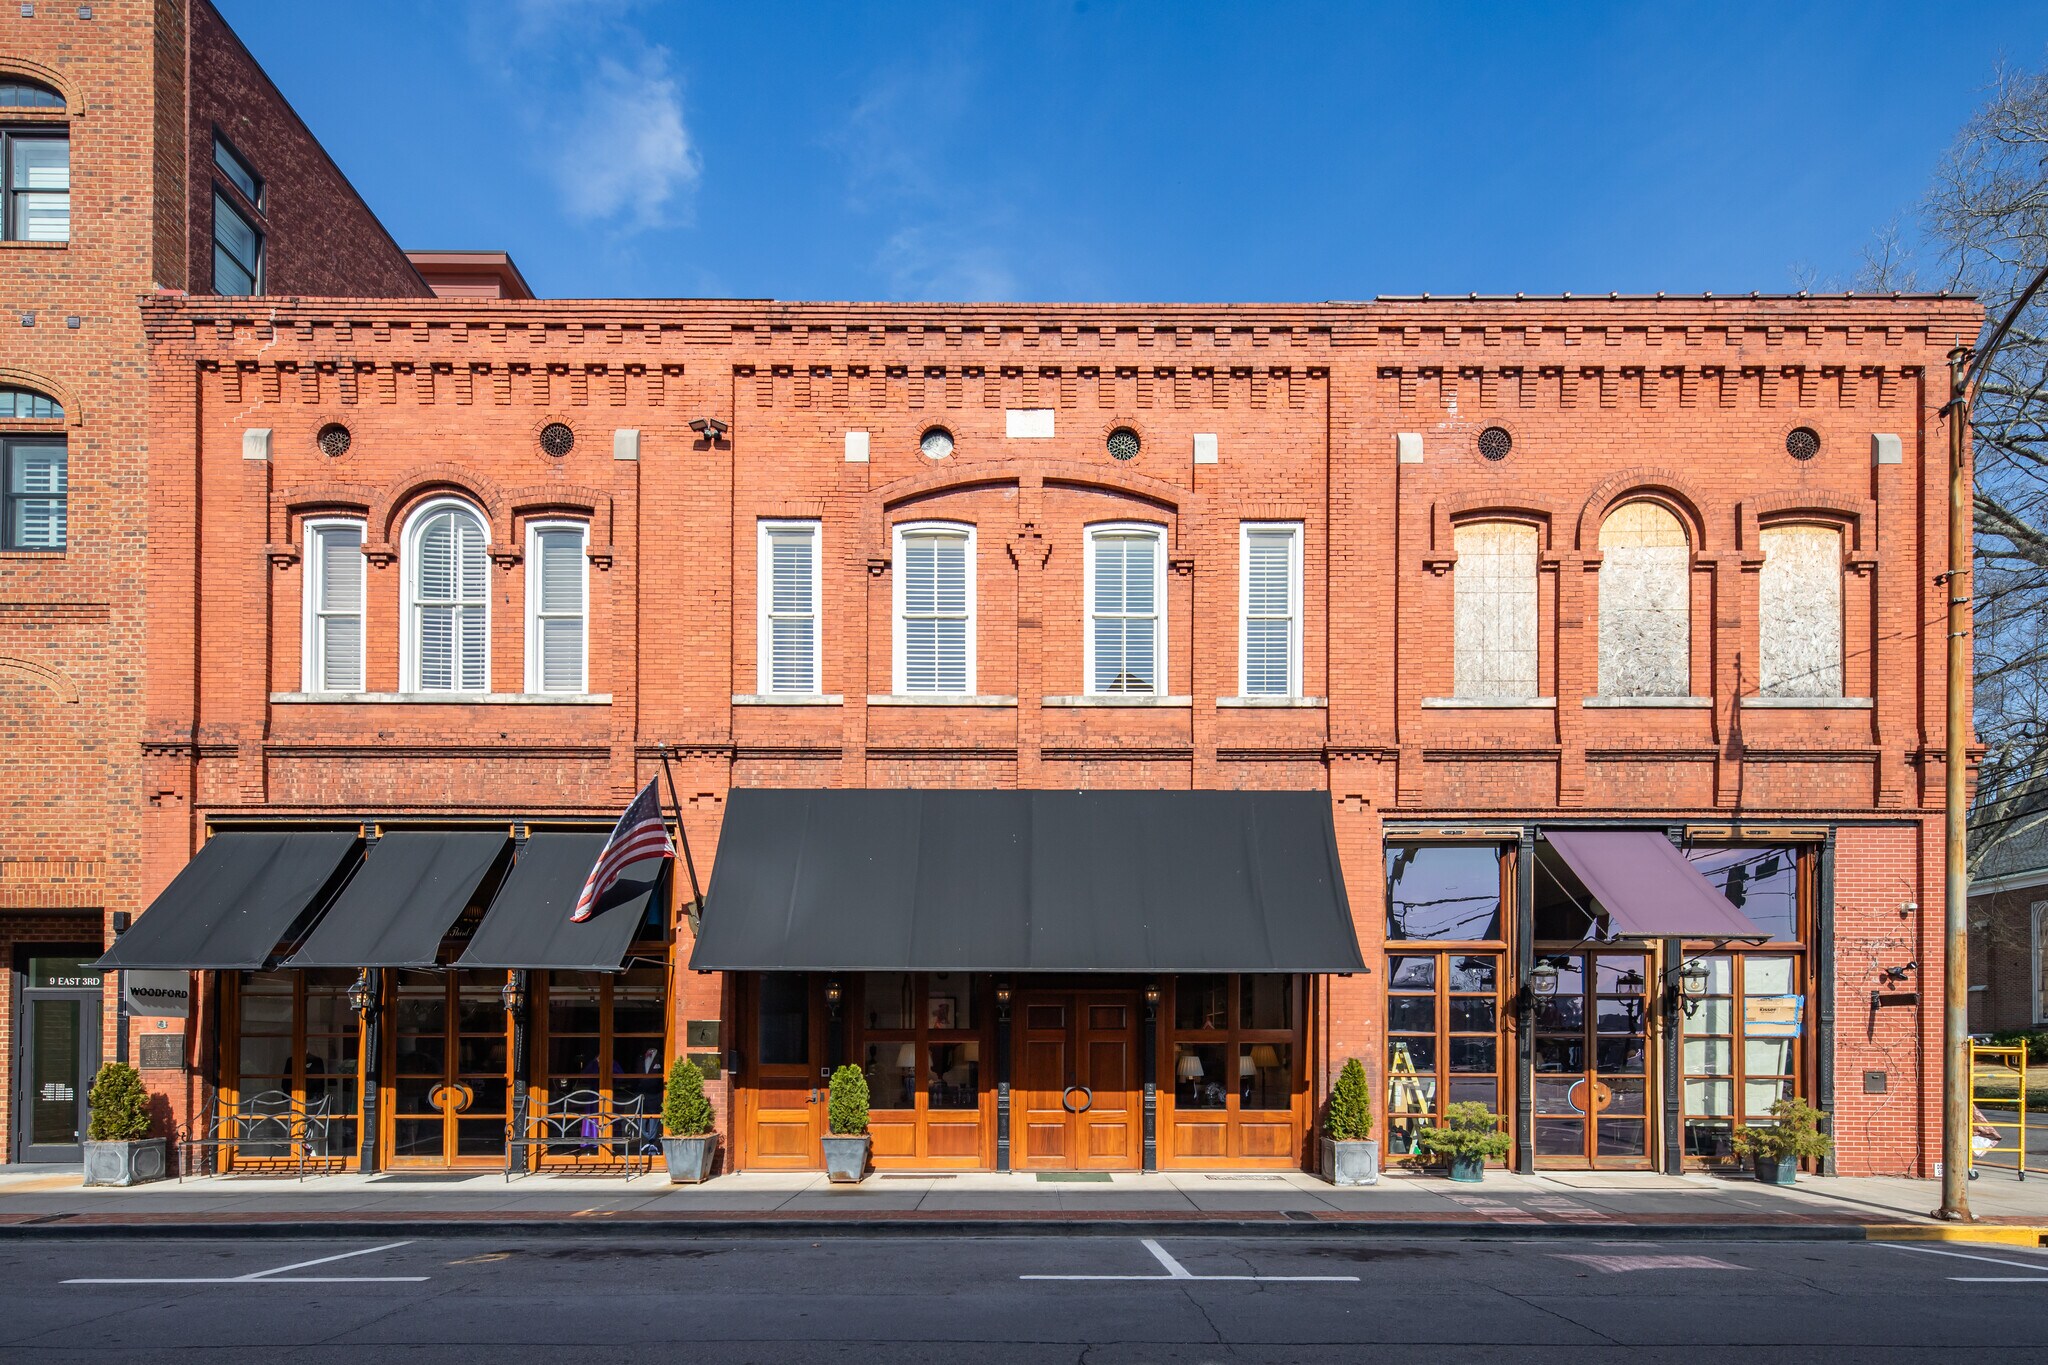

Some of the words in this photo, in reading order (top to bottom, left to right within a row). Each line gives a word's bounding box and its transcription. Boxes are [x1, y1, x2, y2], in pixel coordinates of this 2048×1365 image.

[49, 977, 55, 985] 9
[57, 977, 80, 985] EAST
[82, 977, 100, 985] 3RD
[130, 987, 188, 999] WOODFORD
